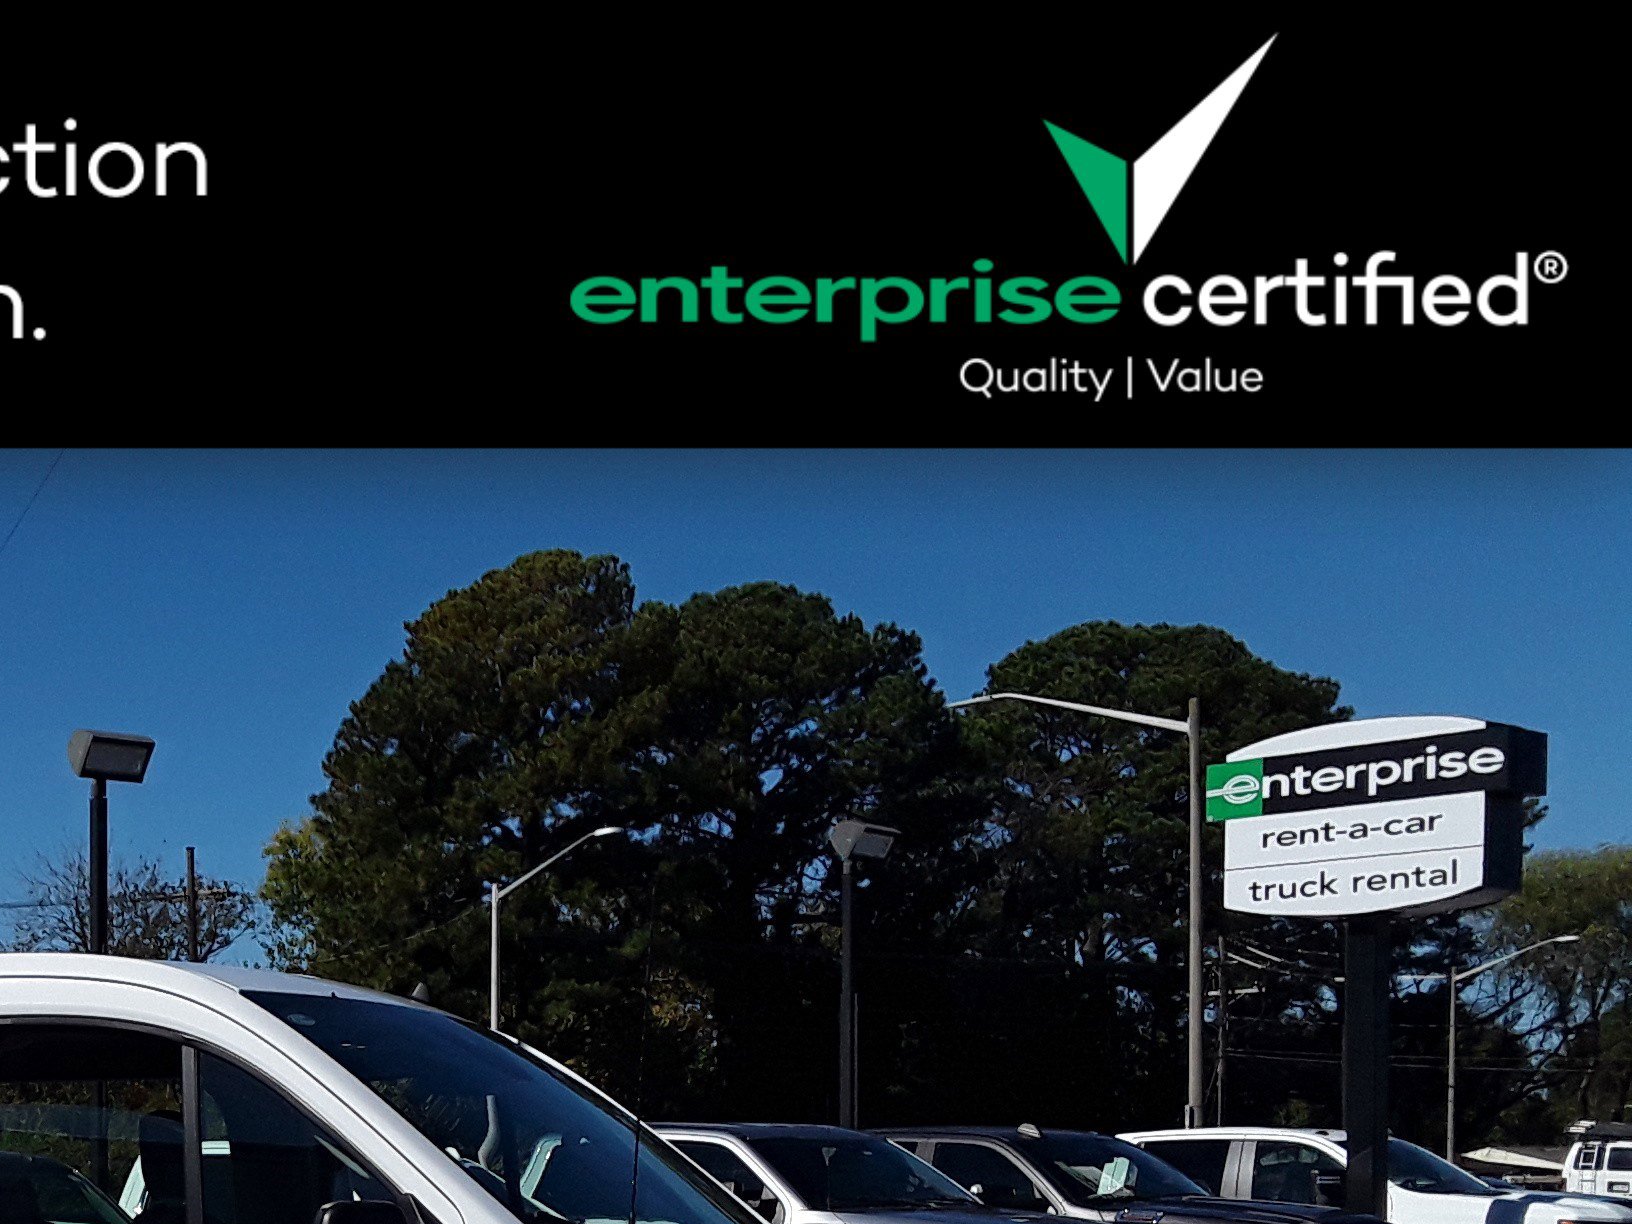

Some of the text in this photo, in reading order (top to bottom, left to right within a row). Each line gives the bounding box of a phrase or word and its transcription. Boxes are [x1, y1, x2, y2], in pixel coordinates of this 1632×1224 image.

[1208, 745, 1506, 804] enterprise
[1261, 813, 1443, 848] rent-a-car
[1248, 858, 1458, 902] truck rental
